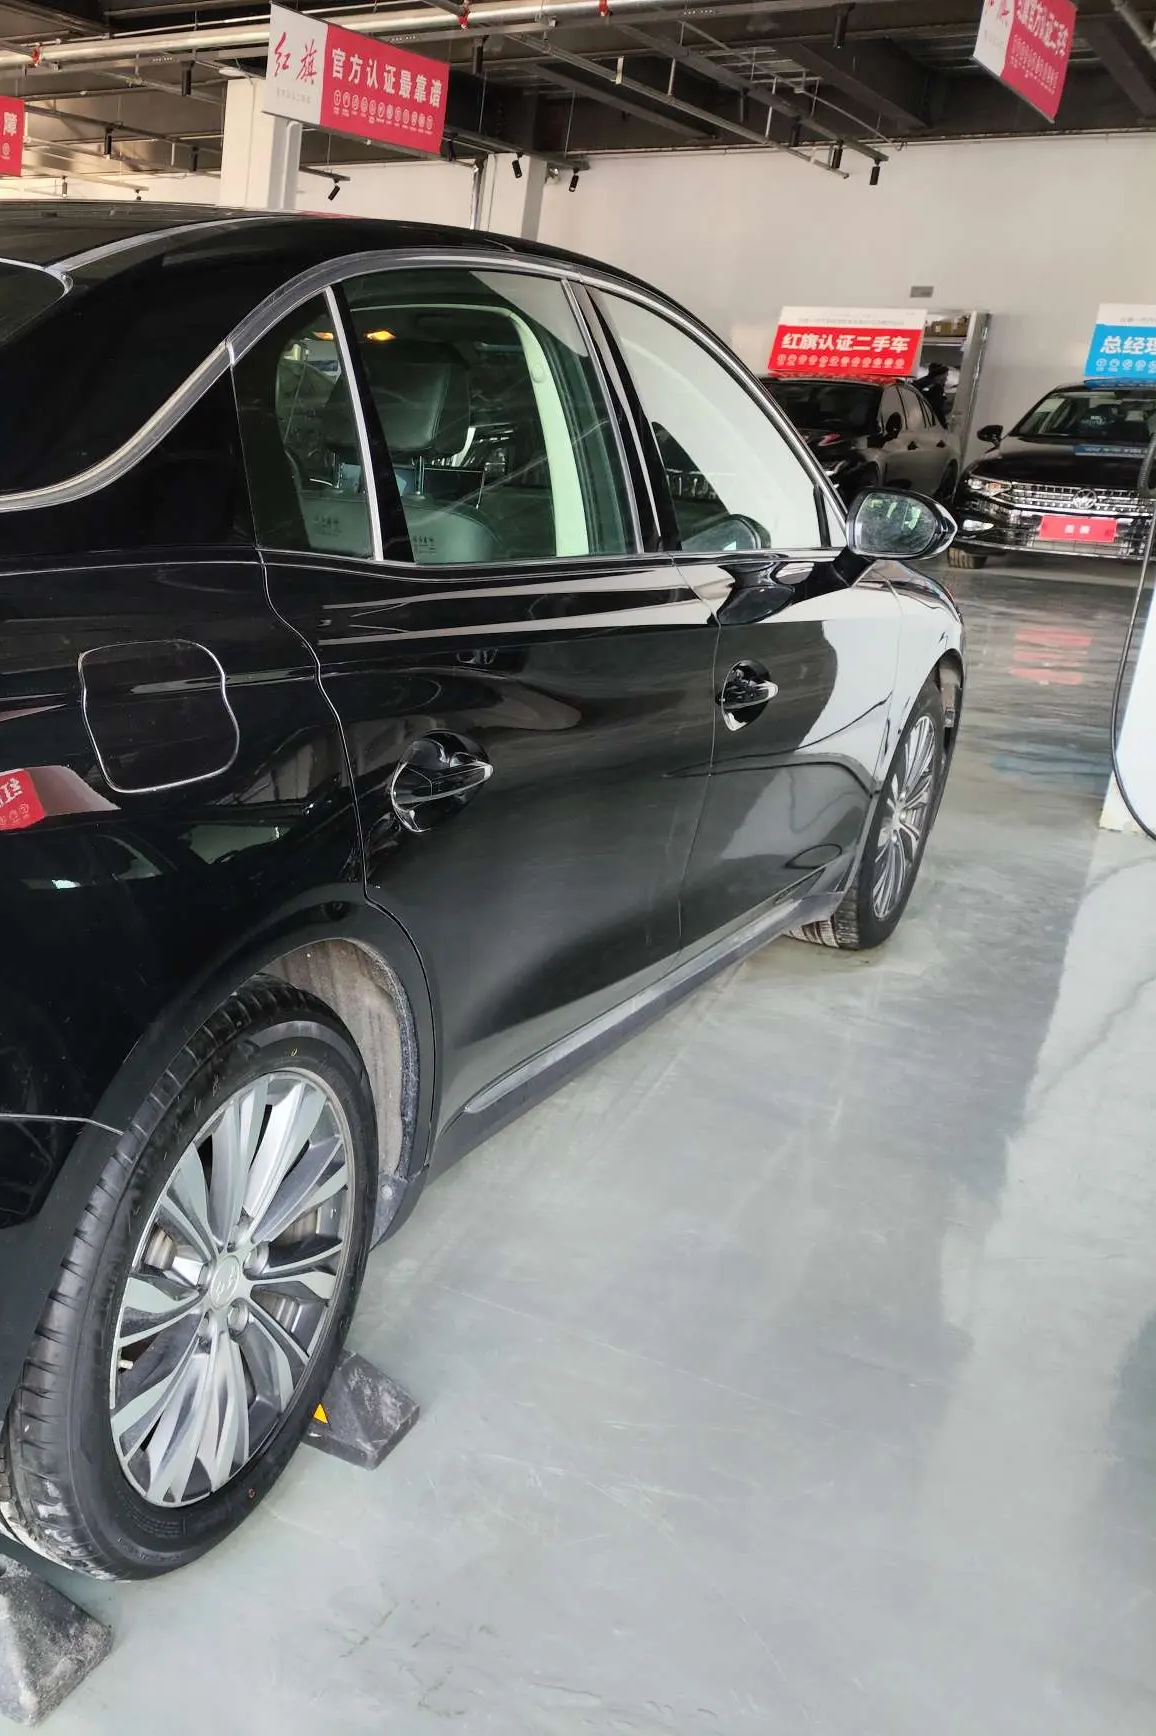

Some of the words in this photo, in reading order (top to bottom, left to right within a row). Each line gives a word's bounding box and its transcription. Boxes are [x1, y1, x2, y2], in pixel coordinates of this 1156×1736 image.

[274, 31, 317, 85] 红旗
[331, 48, 442, 109] 官方认证最靠谱
[781, 332, 911, 354] 红旗认证二手车
